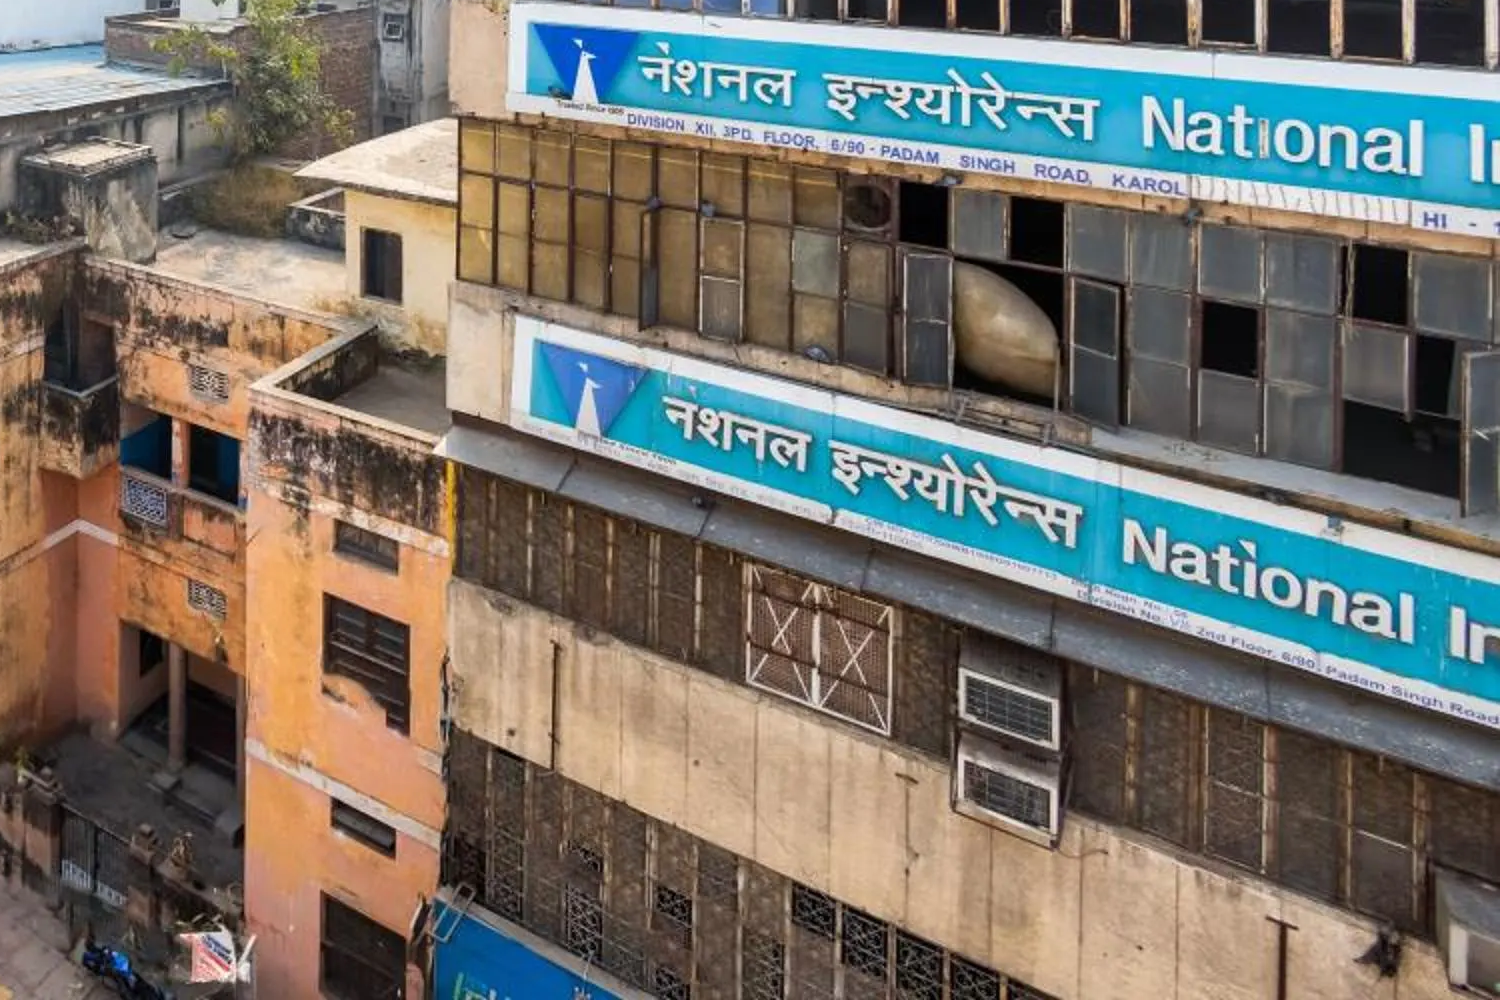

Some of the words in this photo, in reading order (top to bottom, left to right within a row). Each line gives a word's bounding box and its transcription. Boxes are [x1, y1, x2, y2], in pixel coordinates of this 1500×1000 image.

[627, 113, 685, 132] DIVISION
[881, 144, 940, 165] PADAM
[959, 154, 1016, 174] SINGH
[1112, 173, 1188, 197] KAROL
[1141, 95, 1424, 177] National
[1123, 518, 1415, 645] National
[1326, 665, 1387, 693] Padam
[1390, 685, 1445, 710] Singh
